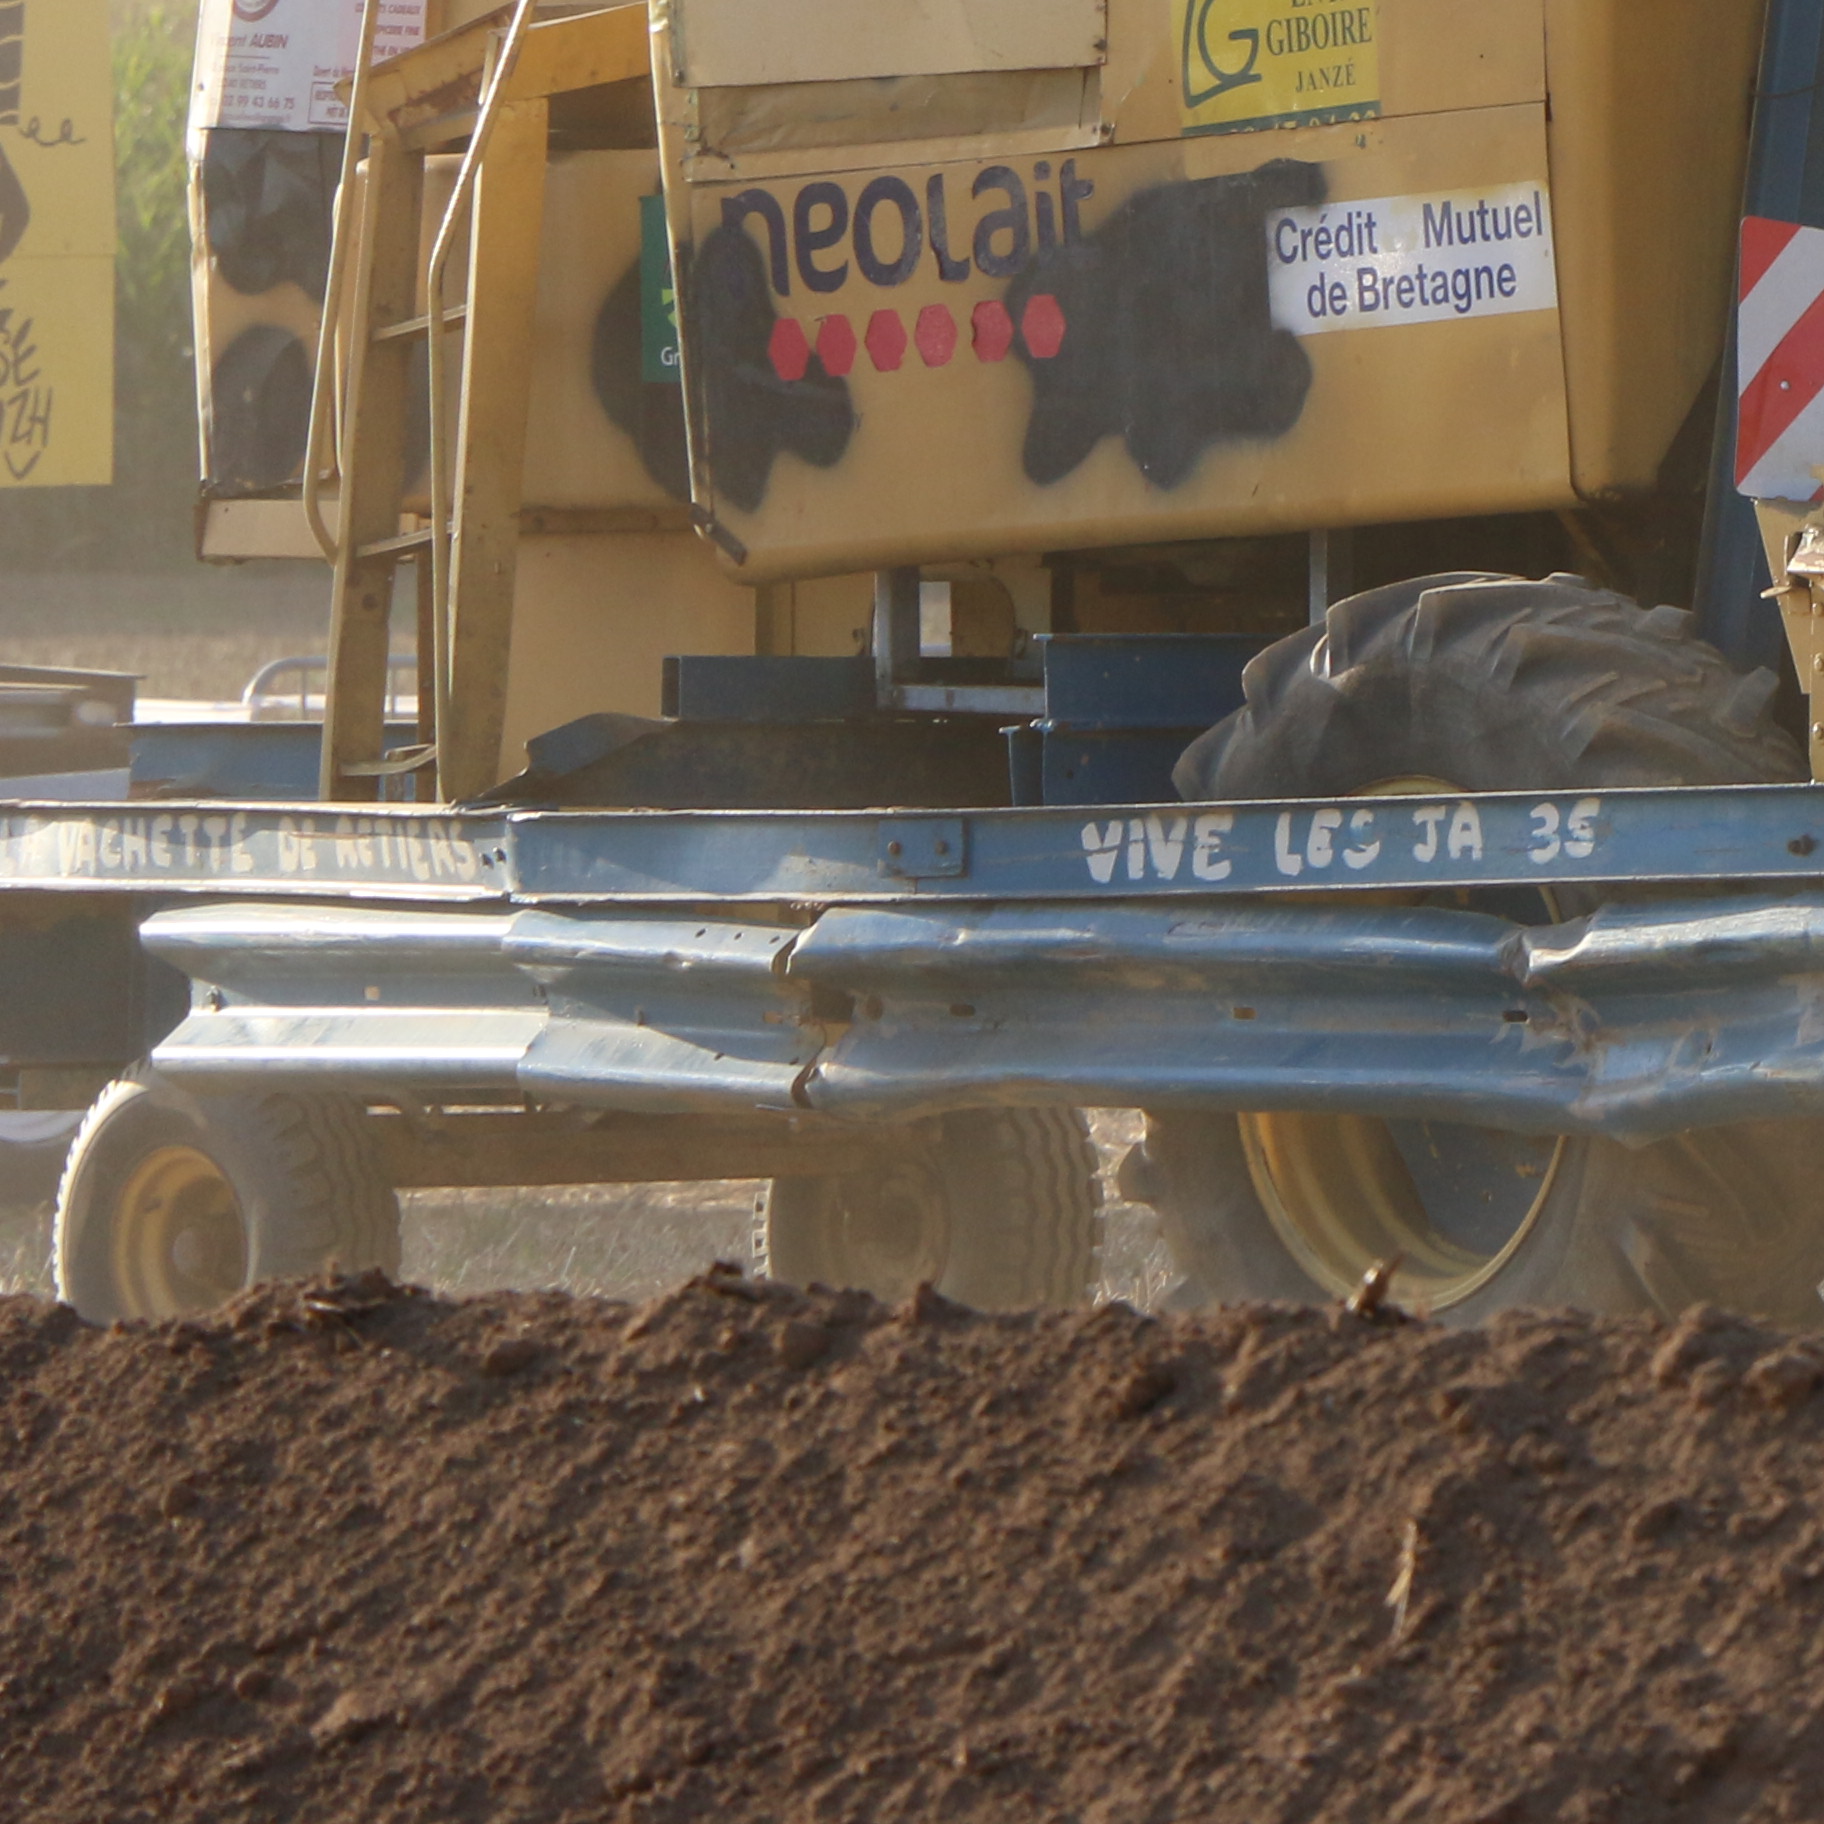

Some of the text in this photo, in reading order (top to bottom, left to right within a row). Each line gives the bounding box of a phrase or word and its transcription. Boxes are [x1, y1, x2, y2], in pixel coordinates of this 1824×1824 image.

[1266, 7, 1372, 56] GIBOIRE
[1295, 58, 1356, 93] JANZÉ
[1275, 190, 1543, 264] Crédit Mutuel
[1307, 262, 1517, 318] de Bretagne
[57, 812, 253, 876] VACHETTE
[277, 815, 316, 872] DE
[1081, 797, 1600, 883] VIVE LES JA 35
